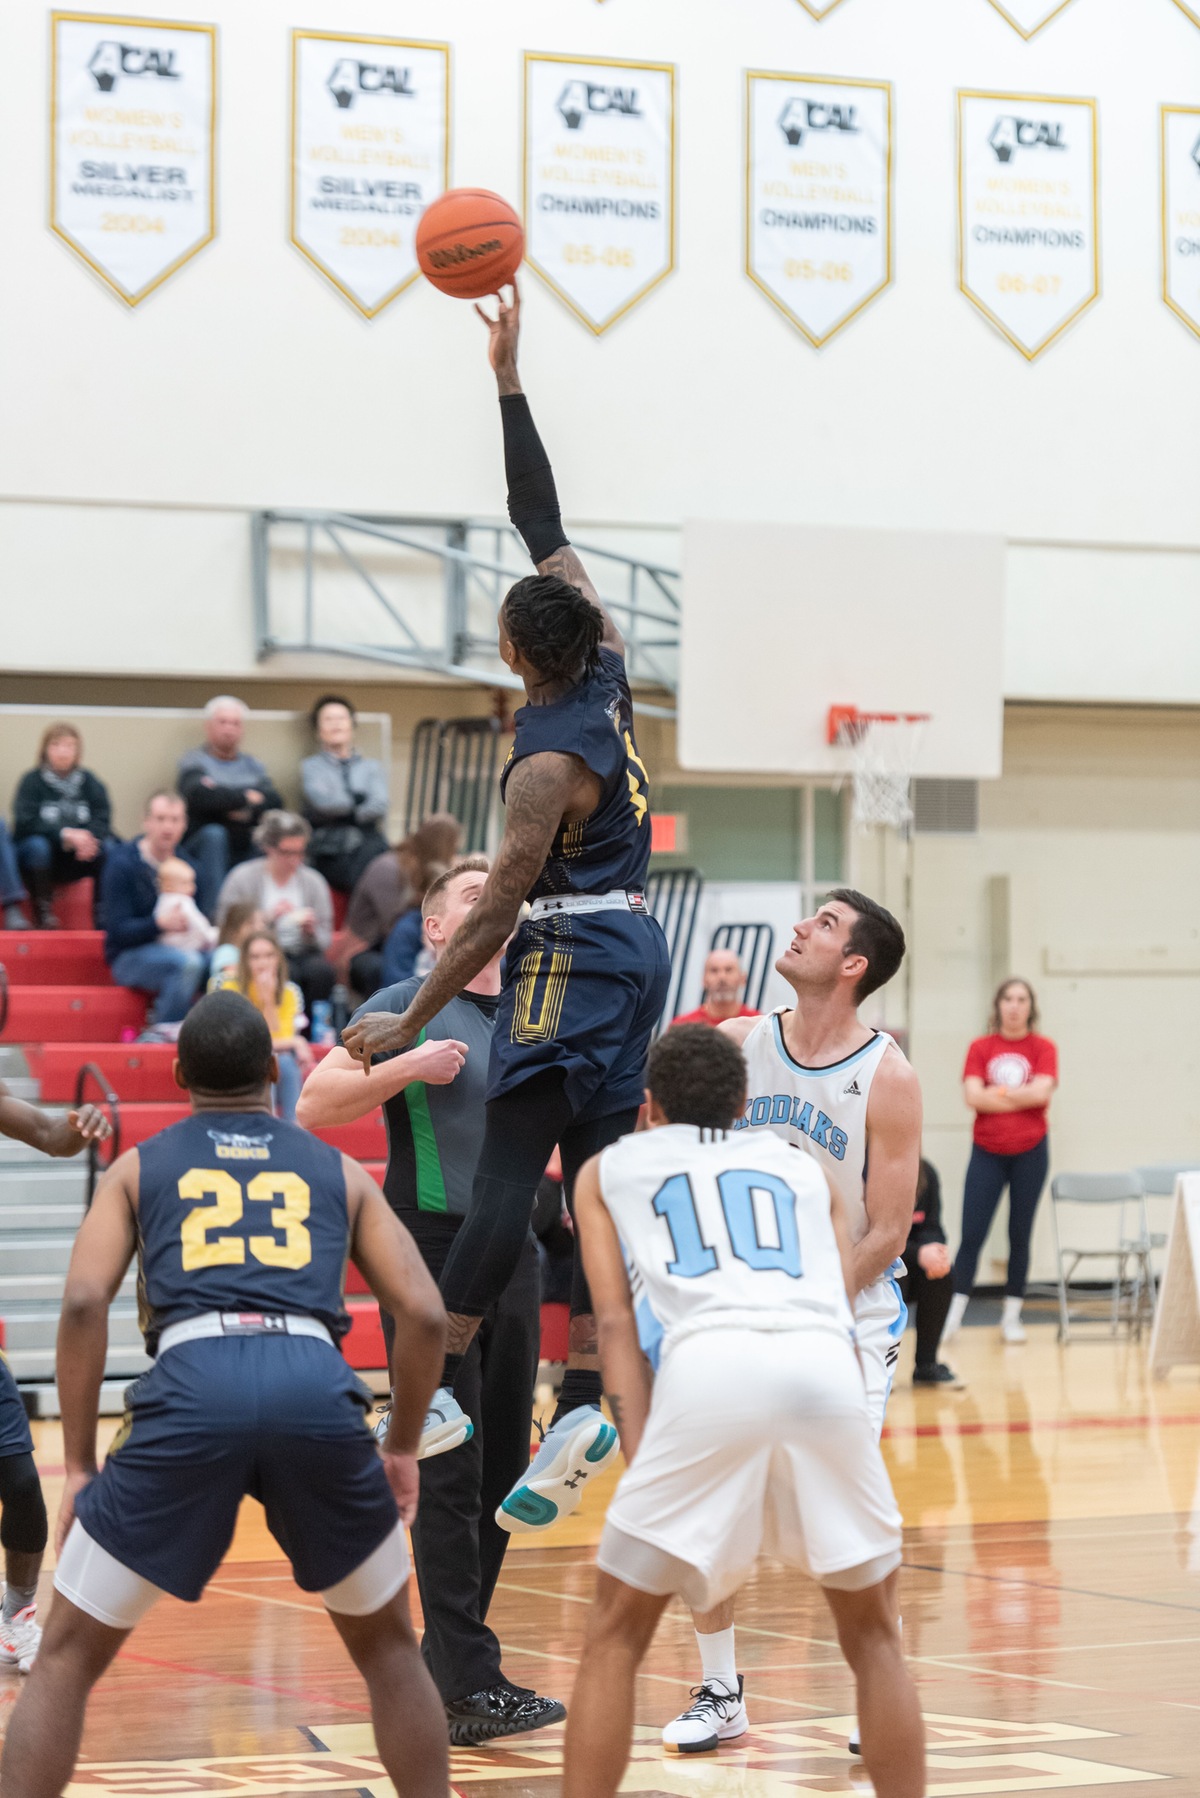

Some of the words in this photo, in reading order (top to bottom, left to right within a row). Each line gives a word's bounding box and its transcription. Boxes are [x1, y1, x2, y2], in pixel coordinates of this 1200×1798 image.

[80, 160, 187, 185] SILVER
[71, 182, 194, 202] MEDALIST
[320, 175, 423, 200] SILVER
[539, 193, 660, 219] CHAMPIONS
[100, 212, 167, 234] 2004
[761, 208, 877, 235] CHAMPIONS
[340, 227, 402, 249] 2004
[973, 225, 1085, 249] CHAMPIONS
[563, 243, 635, 269] 05-06
[783, 258, 854, 283] 05-06
[995, 272, 1062, 296] 06-07
[177, 1167, 312, 1272] 23
[651, 1168, 804, 1279] 10
